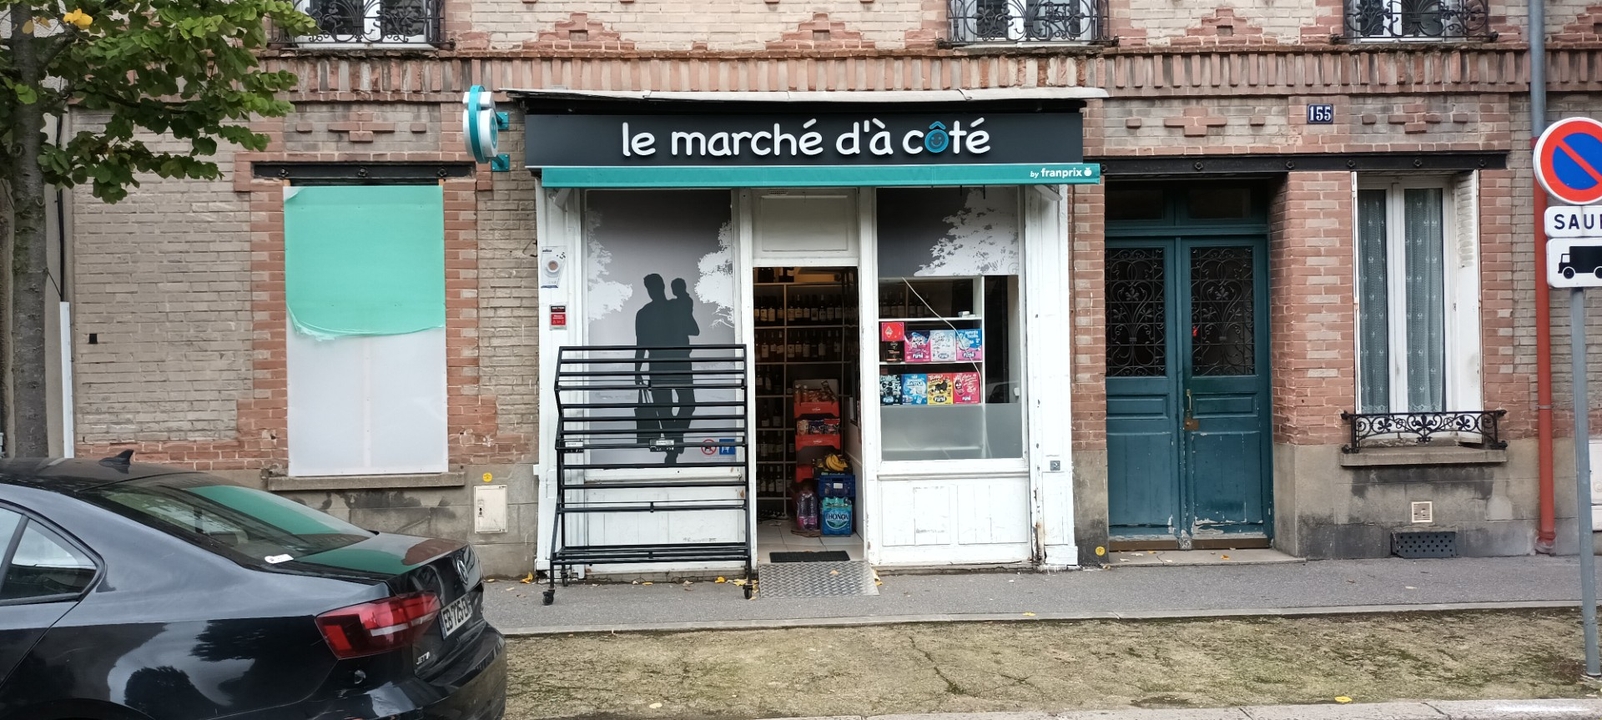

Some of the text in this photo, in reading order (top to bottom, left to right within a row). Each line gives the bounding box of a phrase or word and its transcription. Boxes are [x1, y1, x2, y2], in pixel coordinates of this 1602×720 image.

[1309, 106, 1331, 121] 155
[622, 117, 991, 157] le marché d'à côté
[1030, 167, 1083, 179] by franprix
[1554, 213, 1602, 230] SAU
